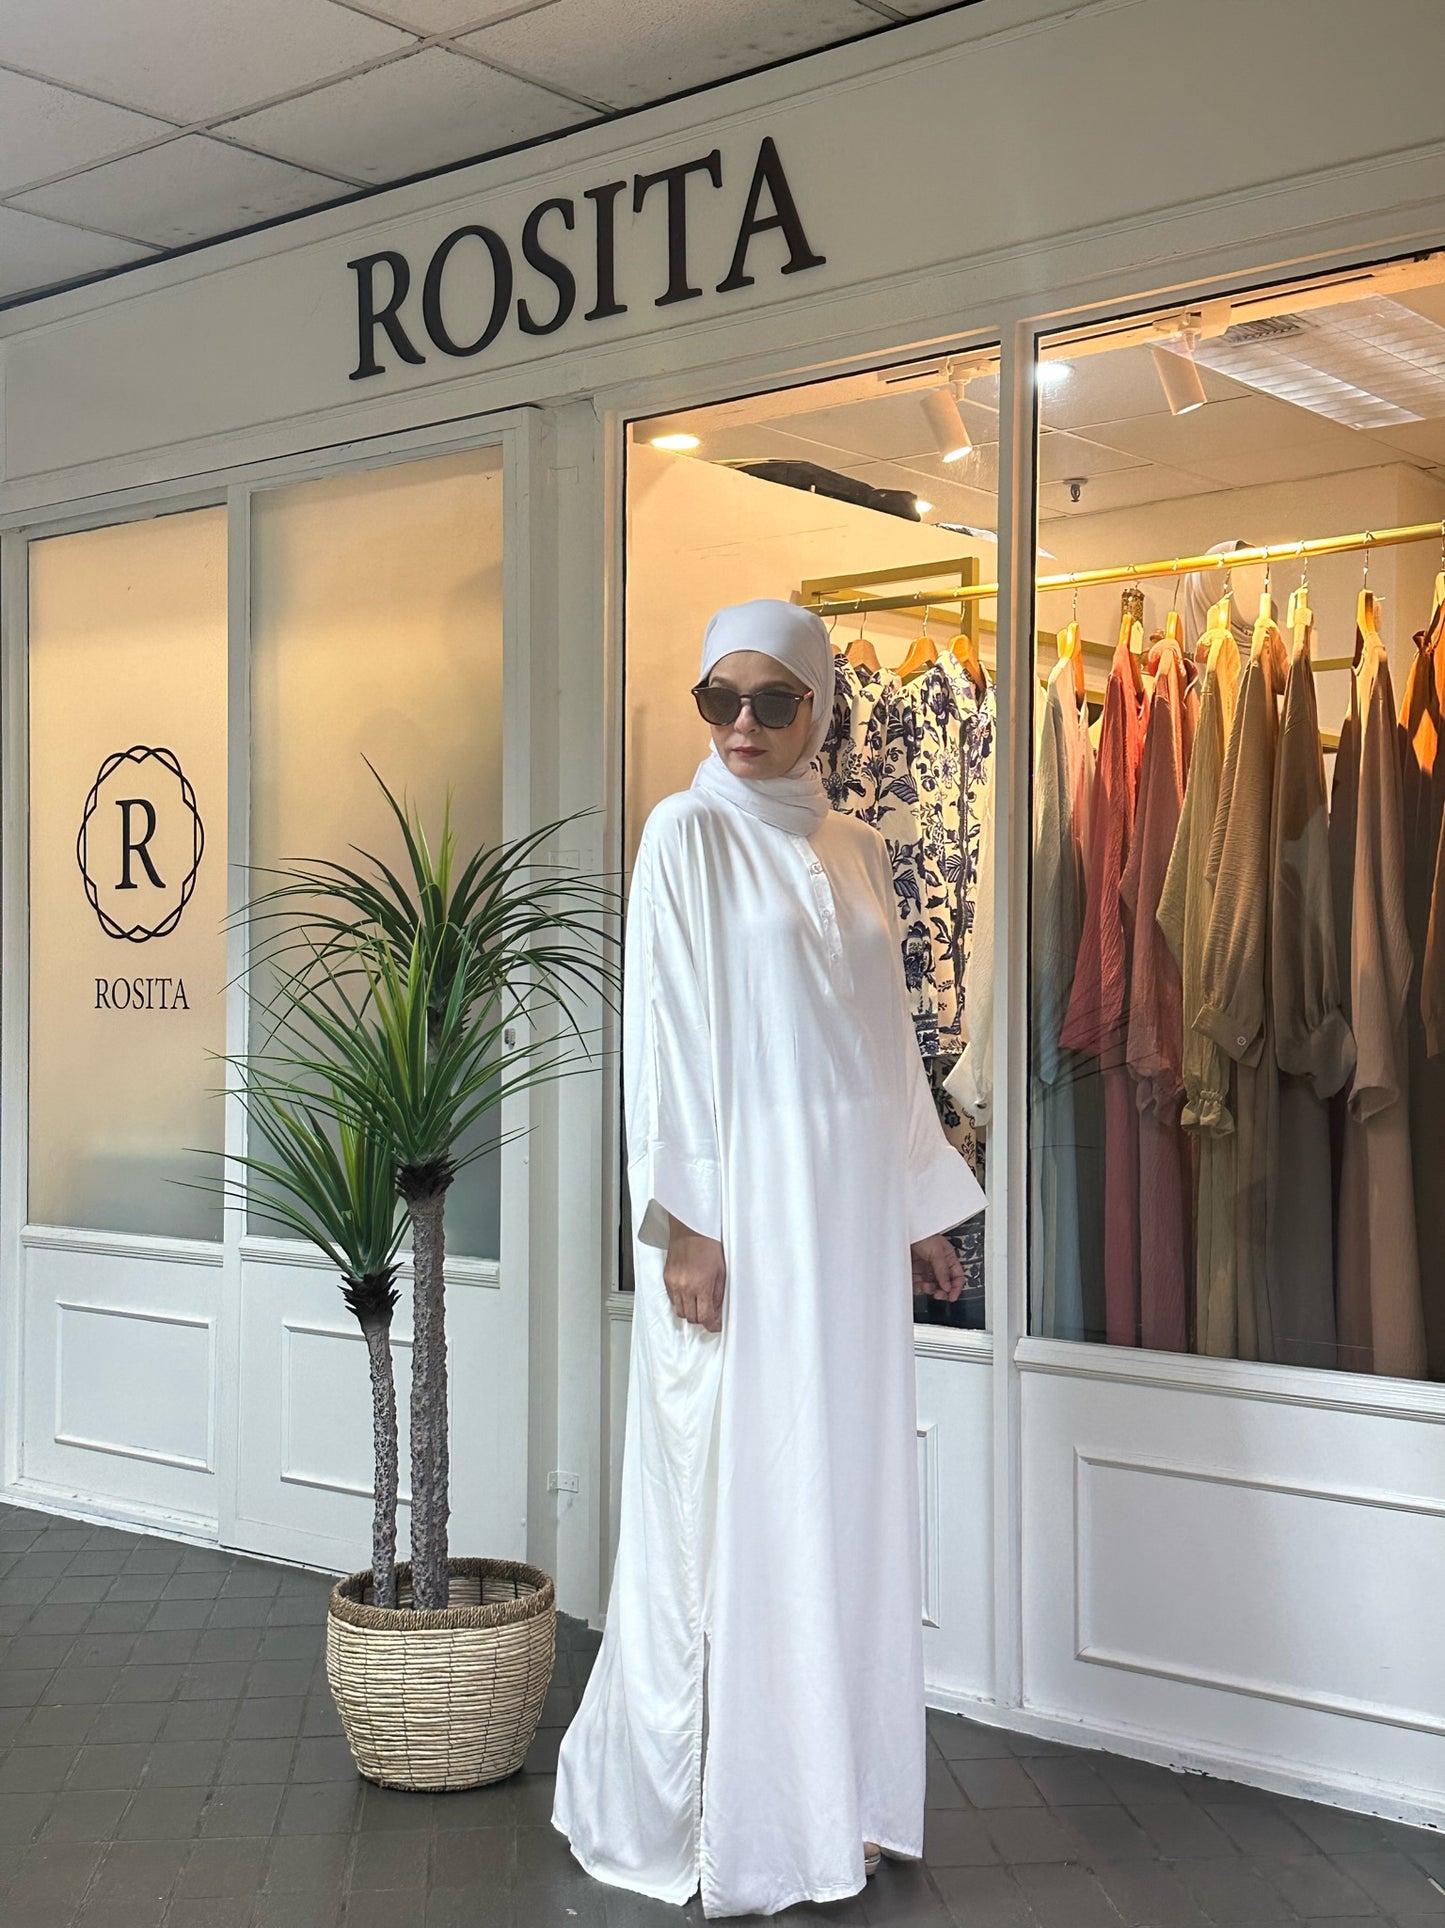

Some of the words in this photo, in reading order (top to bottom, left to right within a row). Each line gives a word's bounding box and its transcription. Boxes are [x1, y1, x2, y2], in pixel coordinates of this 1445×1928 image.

[347, 136, 827, 381] ROSITA
[114, 798, 167, 890] R
[94, 977, 191, 1010] ROSITA
